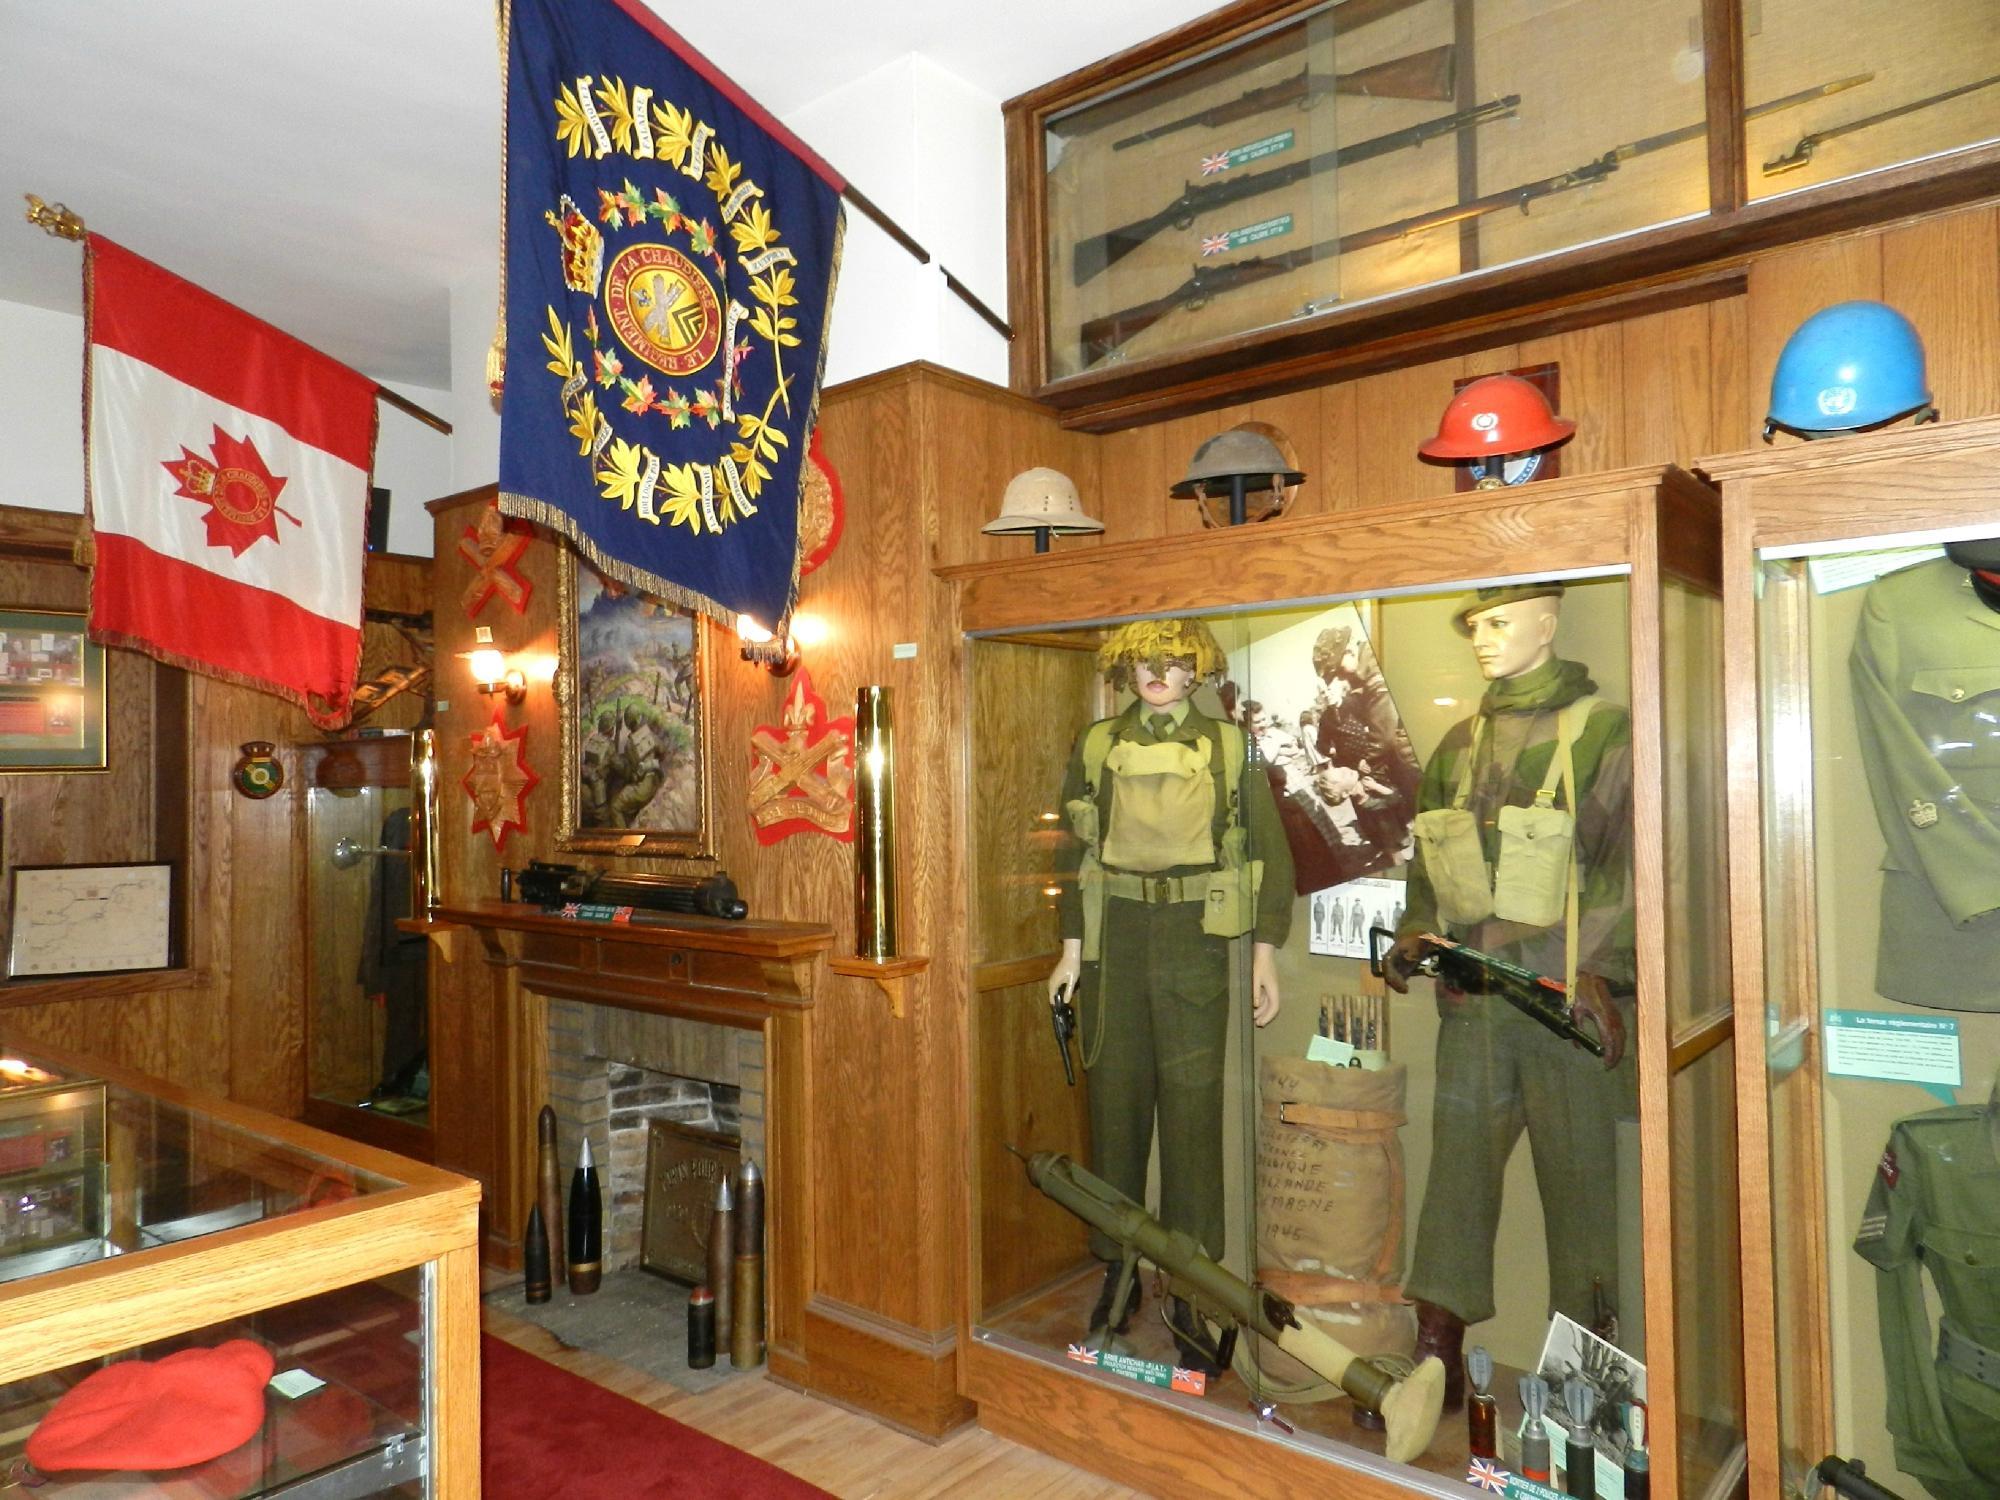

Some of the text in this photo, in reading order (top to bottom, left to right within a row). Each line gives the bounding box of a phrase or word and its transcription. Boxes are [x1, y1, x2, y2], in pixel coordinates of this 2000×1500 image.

[637, 96, 651, 151] FALAISE
[621, 255, 639, 275] LA
[611, 276, 626, 299] DE
[683, 349, 705, 368] LE
